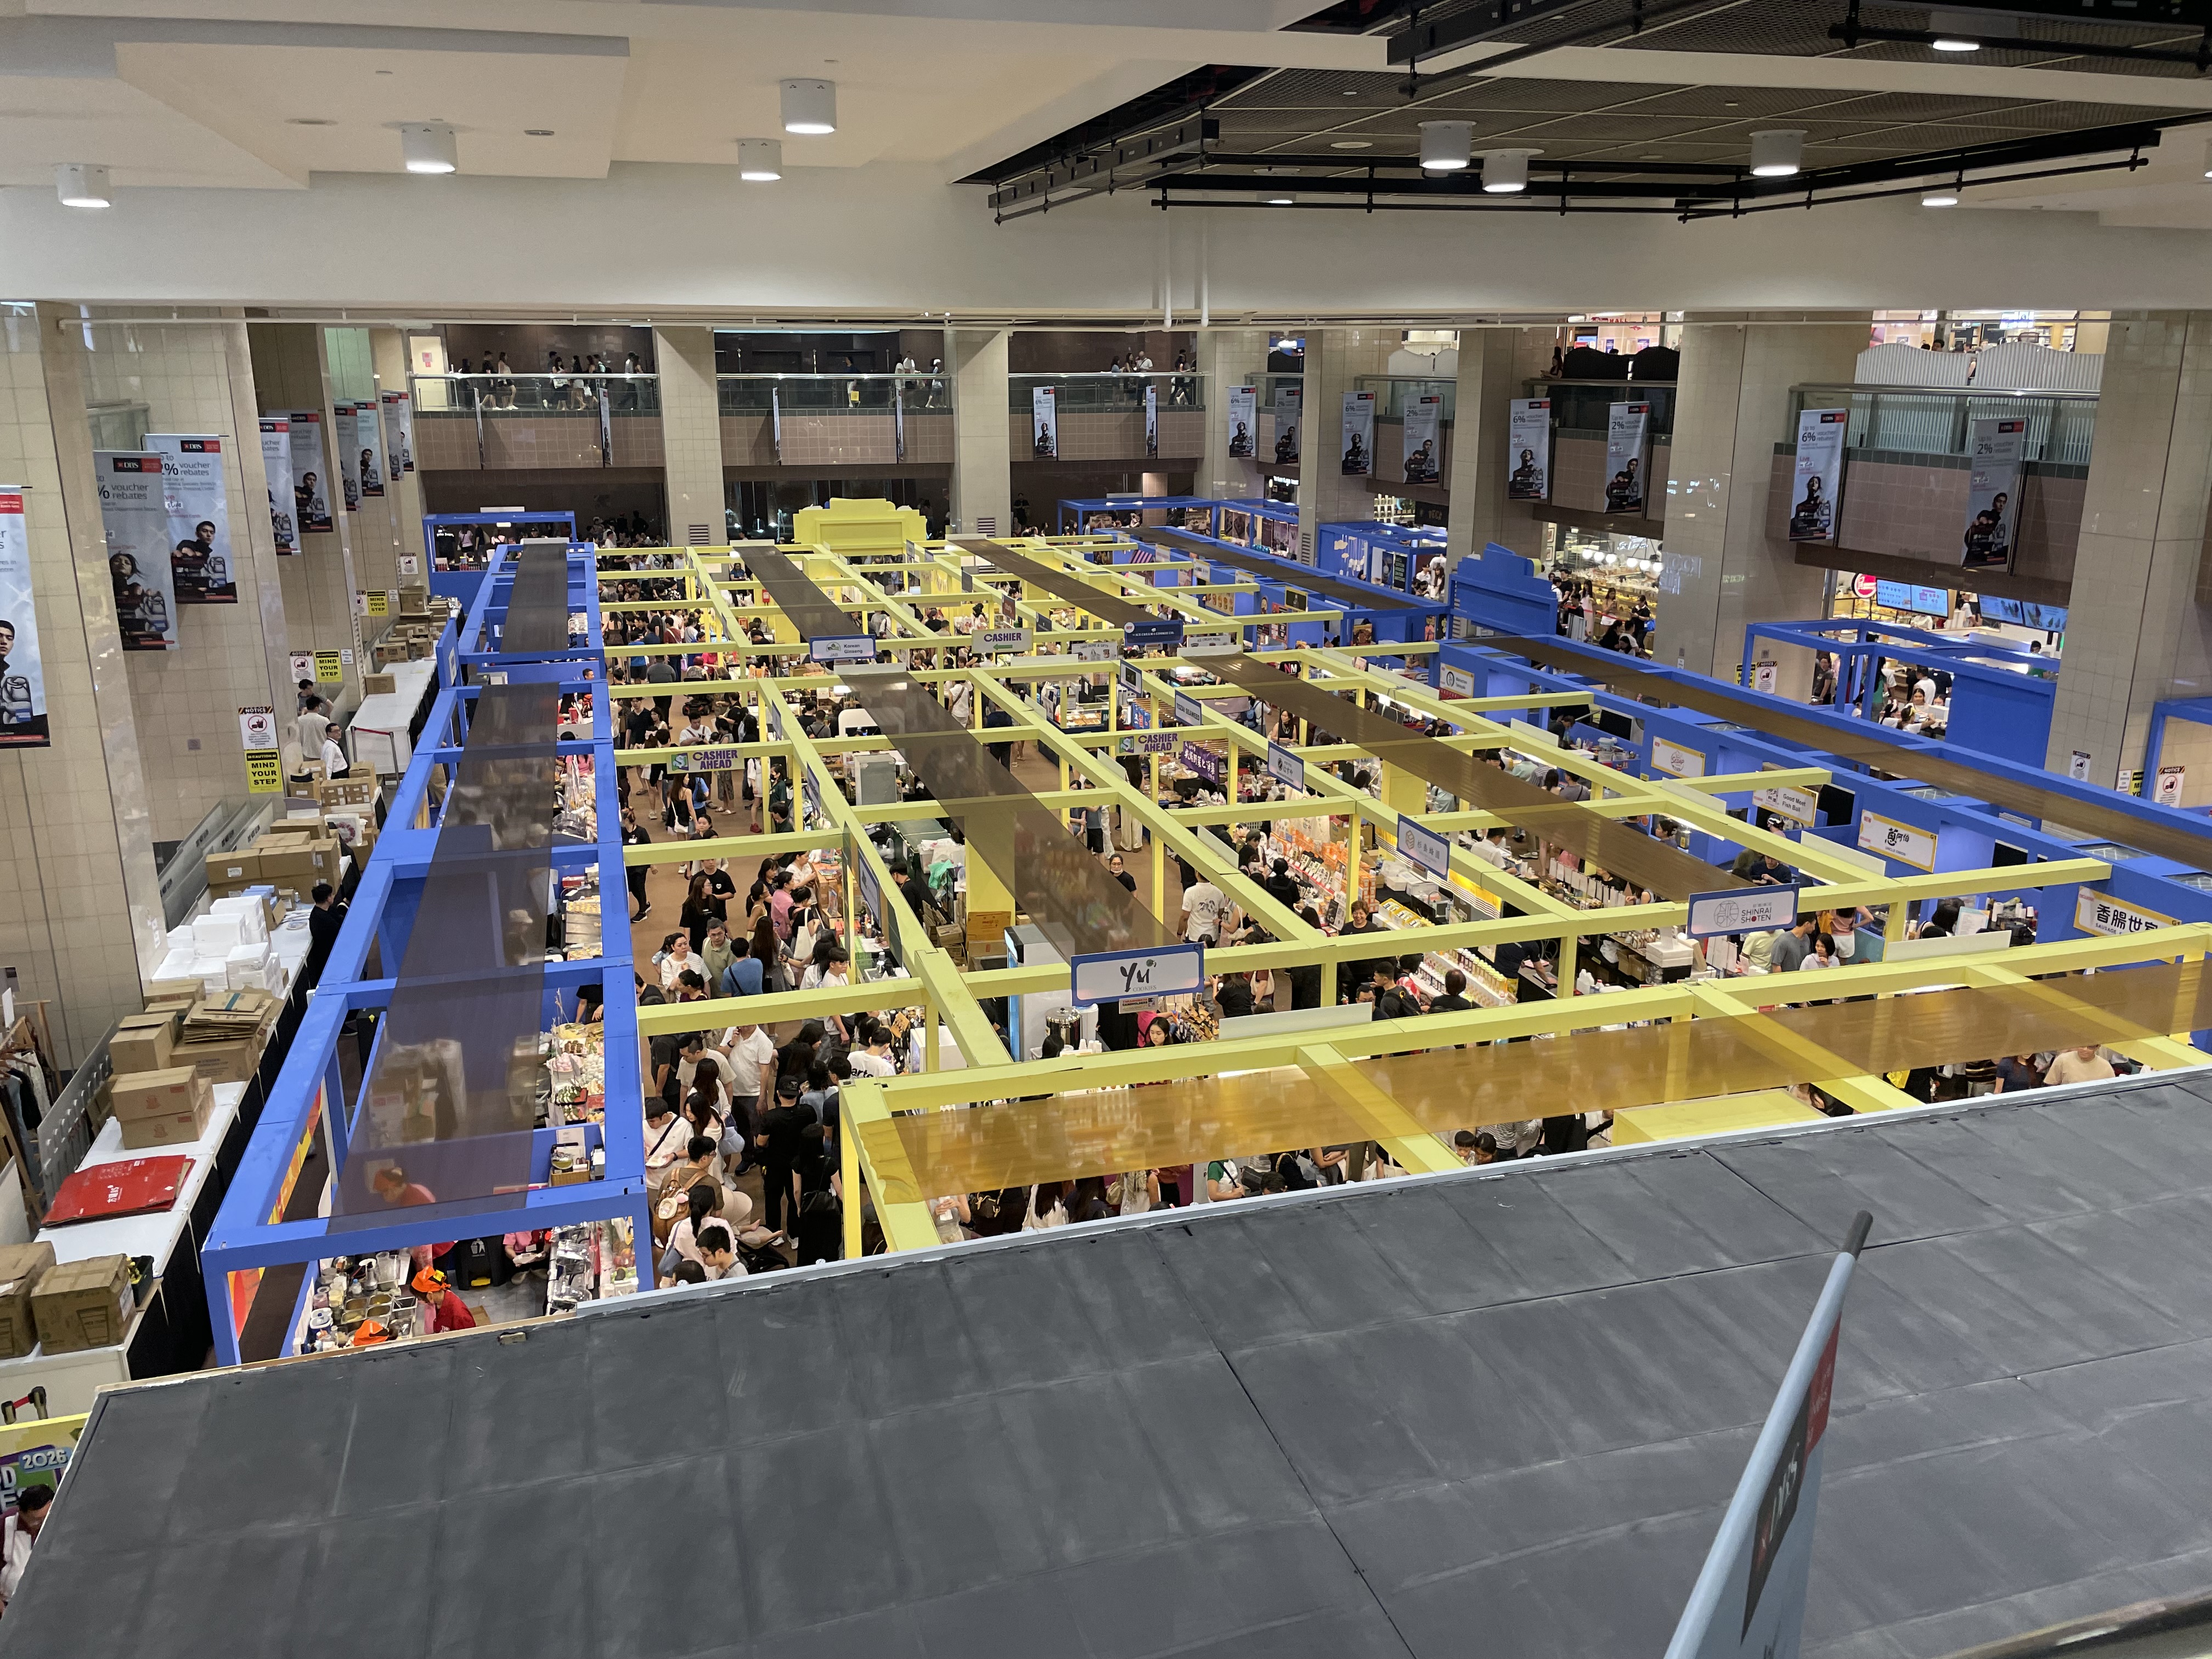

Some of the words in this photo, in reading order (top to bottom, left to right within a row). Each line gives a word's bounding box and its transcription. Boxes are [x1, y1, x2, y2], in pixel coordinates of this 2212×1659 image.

[1612, 421, 1624, 430] 2%
[1802, 432, 1816, 442] 6%
[1977, 443, 1993, 454] 2%
[111, 483, 149, 492] voucher
[984, 633, 1022, 642] CASHIER
[1284, 663, 1297, 674] NM
[1176, 703, 1185, 713] TOZAI
[1186, 708, 1200, 721] SEAWEED
[1138, 733, 1178, 744] CASHIER
[1144, 742, 1172, 753] AHEAD
[692, 749, 738, 761] CASHIER
[699, 759, 732, 770] AHEAD
[1783, 793, 1795, 803] Good
[1782, 800, 1792, 809] Fish
[1792, 804, 1801, 812] Ball
[1741, 907, 1772, 917] SHINRAI
[1741, 913, 1771, 924] SHOTEN
[2096, 923, 2117, 935] SAUSAGE
[1120, 959, 1155, 992] Yui
[22, 1449, 67, 1469] 2026
